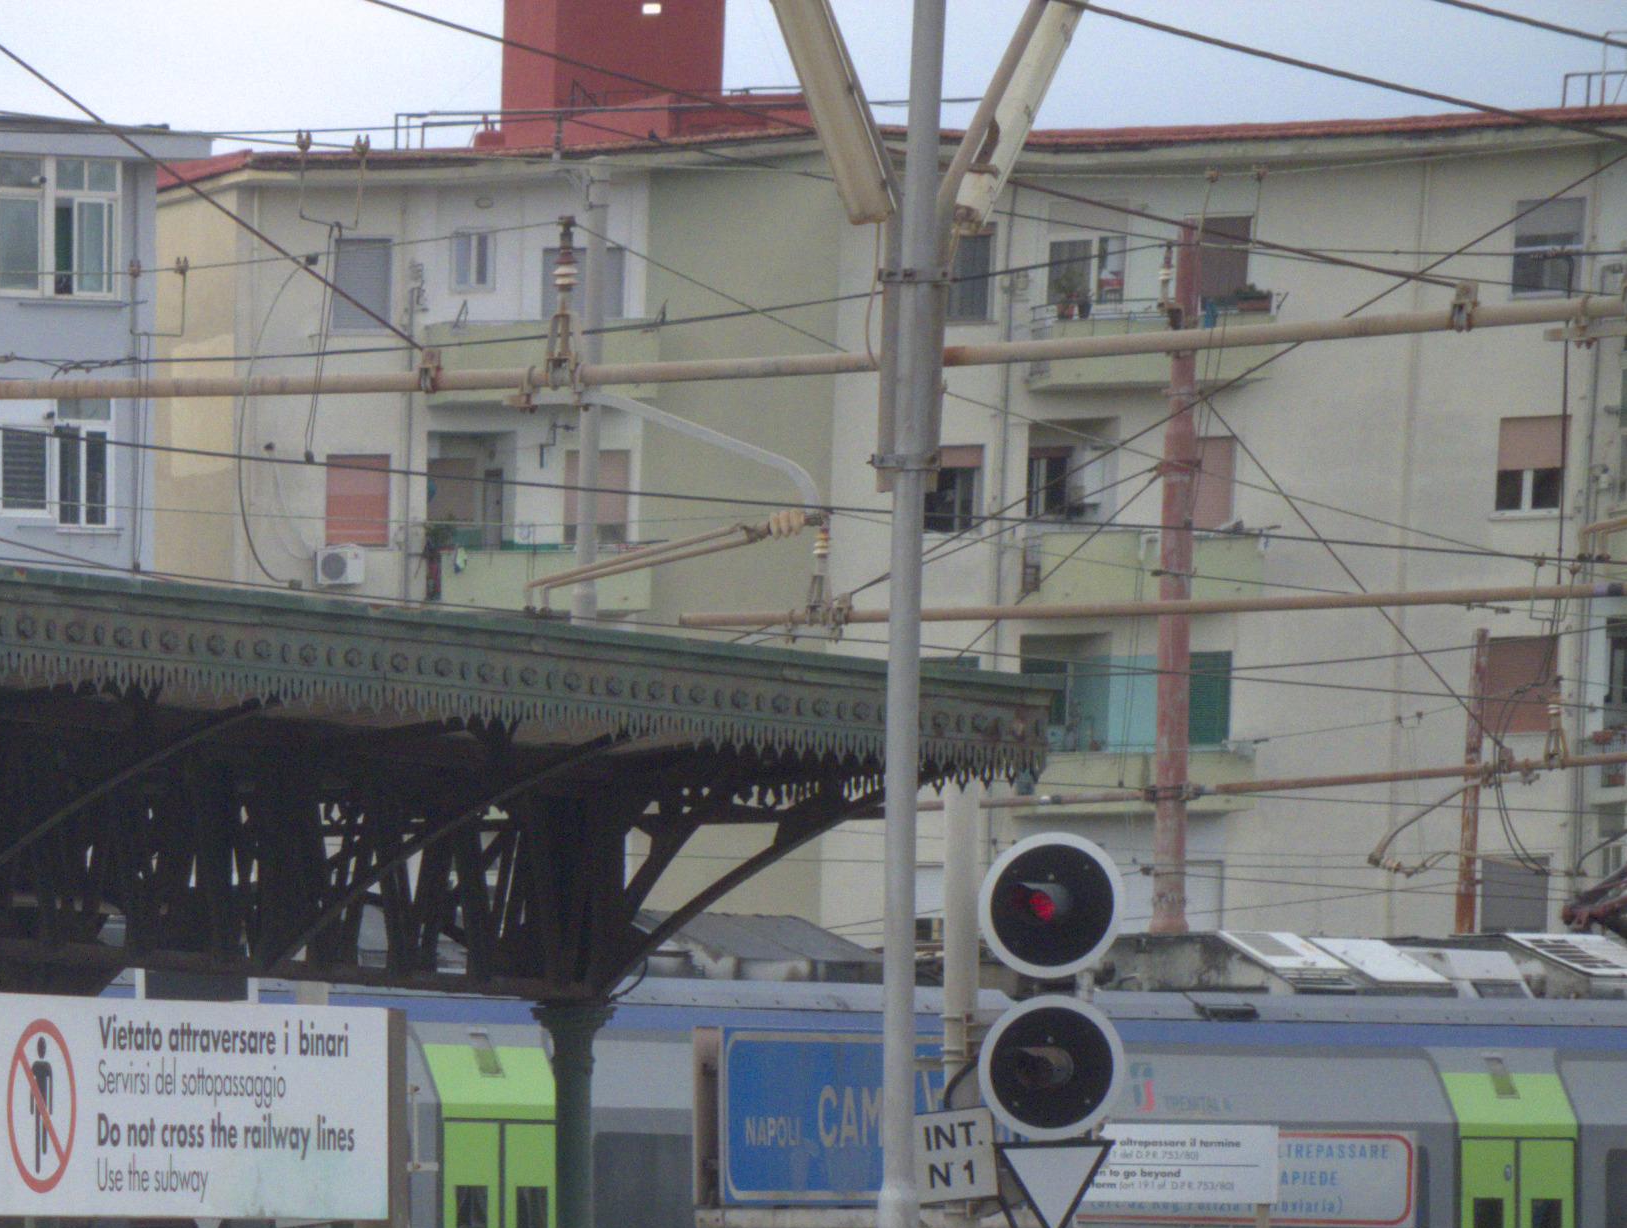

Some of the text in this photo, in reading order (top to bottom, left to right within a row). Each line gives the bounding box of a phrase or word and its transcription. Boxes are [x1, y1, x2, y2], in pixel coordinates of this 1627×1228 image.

[98, 1014, 349, 1057] Vietato attraversare i binari
[97, 1056, 286, 1108] Servirsi del sottopassaggio
[97, 1112, 355, 1161] Do not cross the railway lines
[744, 1116, 802, 1147] NAPOLI
[924, 1120, 984, 1151] INT.
[1119, 1137, 1241, 1149] oltrepassare il termine
[97, 1153, 209, 1203] Use the subway
[962, 1159, 975, 1185] 1
[1123, 1169, 1137, 1180] go
[1140, 1168, 1181, 1180] beyond
